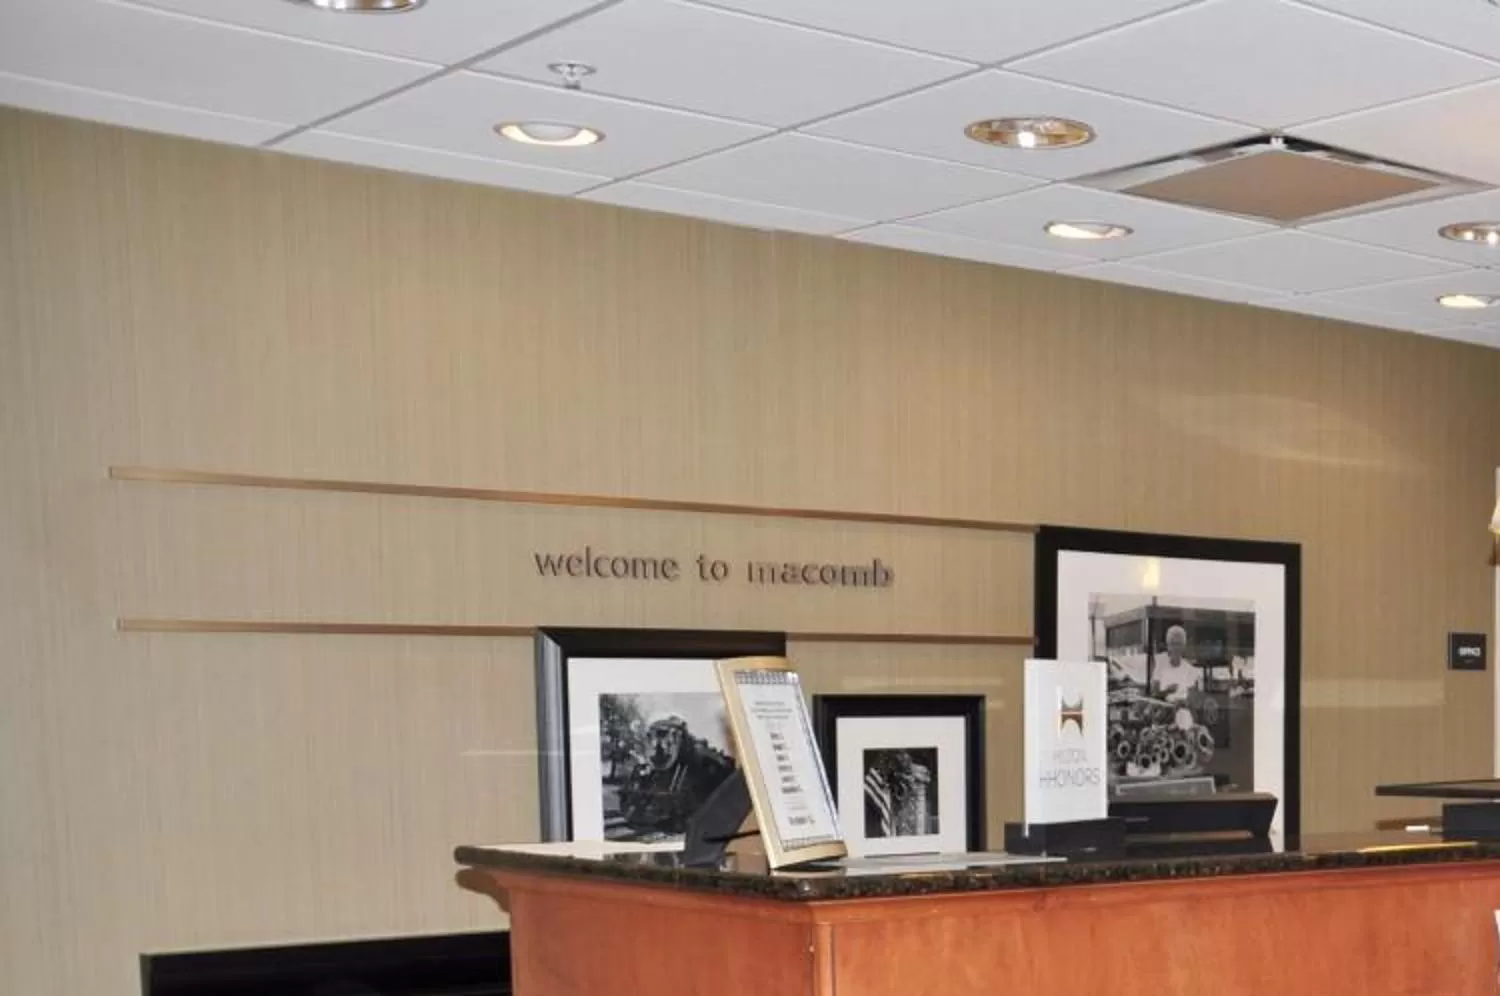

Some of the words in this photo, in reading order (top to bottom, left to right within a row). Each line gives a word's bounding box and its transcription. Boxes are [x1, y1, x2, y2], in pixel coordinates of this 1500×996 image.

[534, 545, 681, 581] welcome
[696, 552, 729, 583] to
[746, 557, 895, 588] macomb
